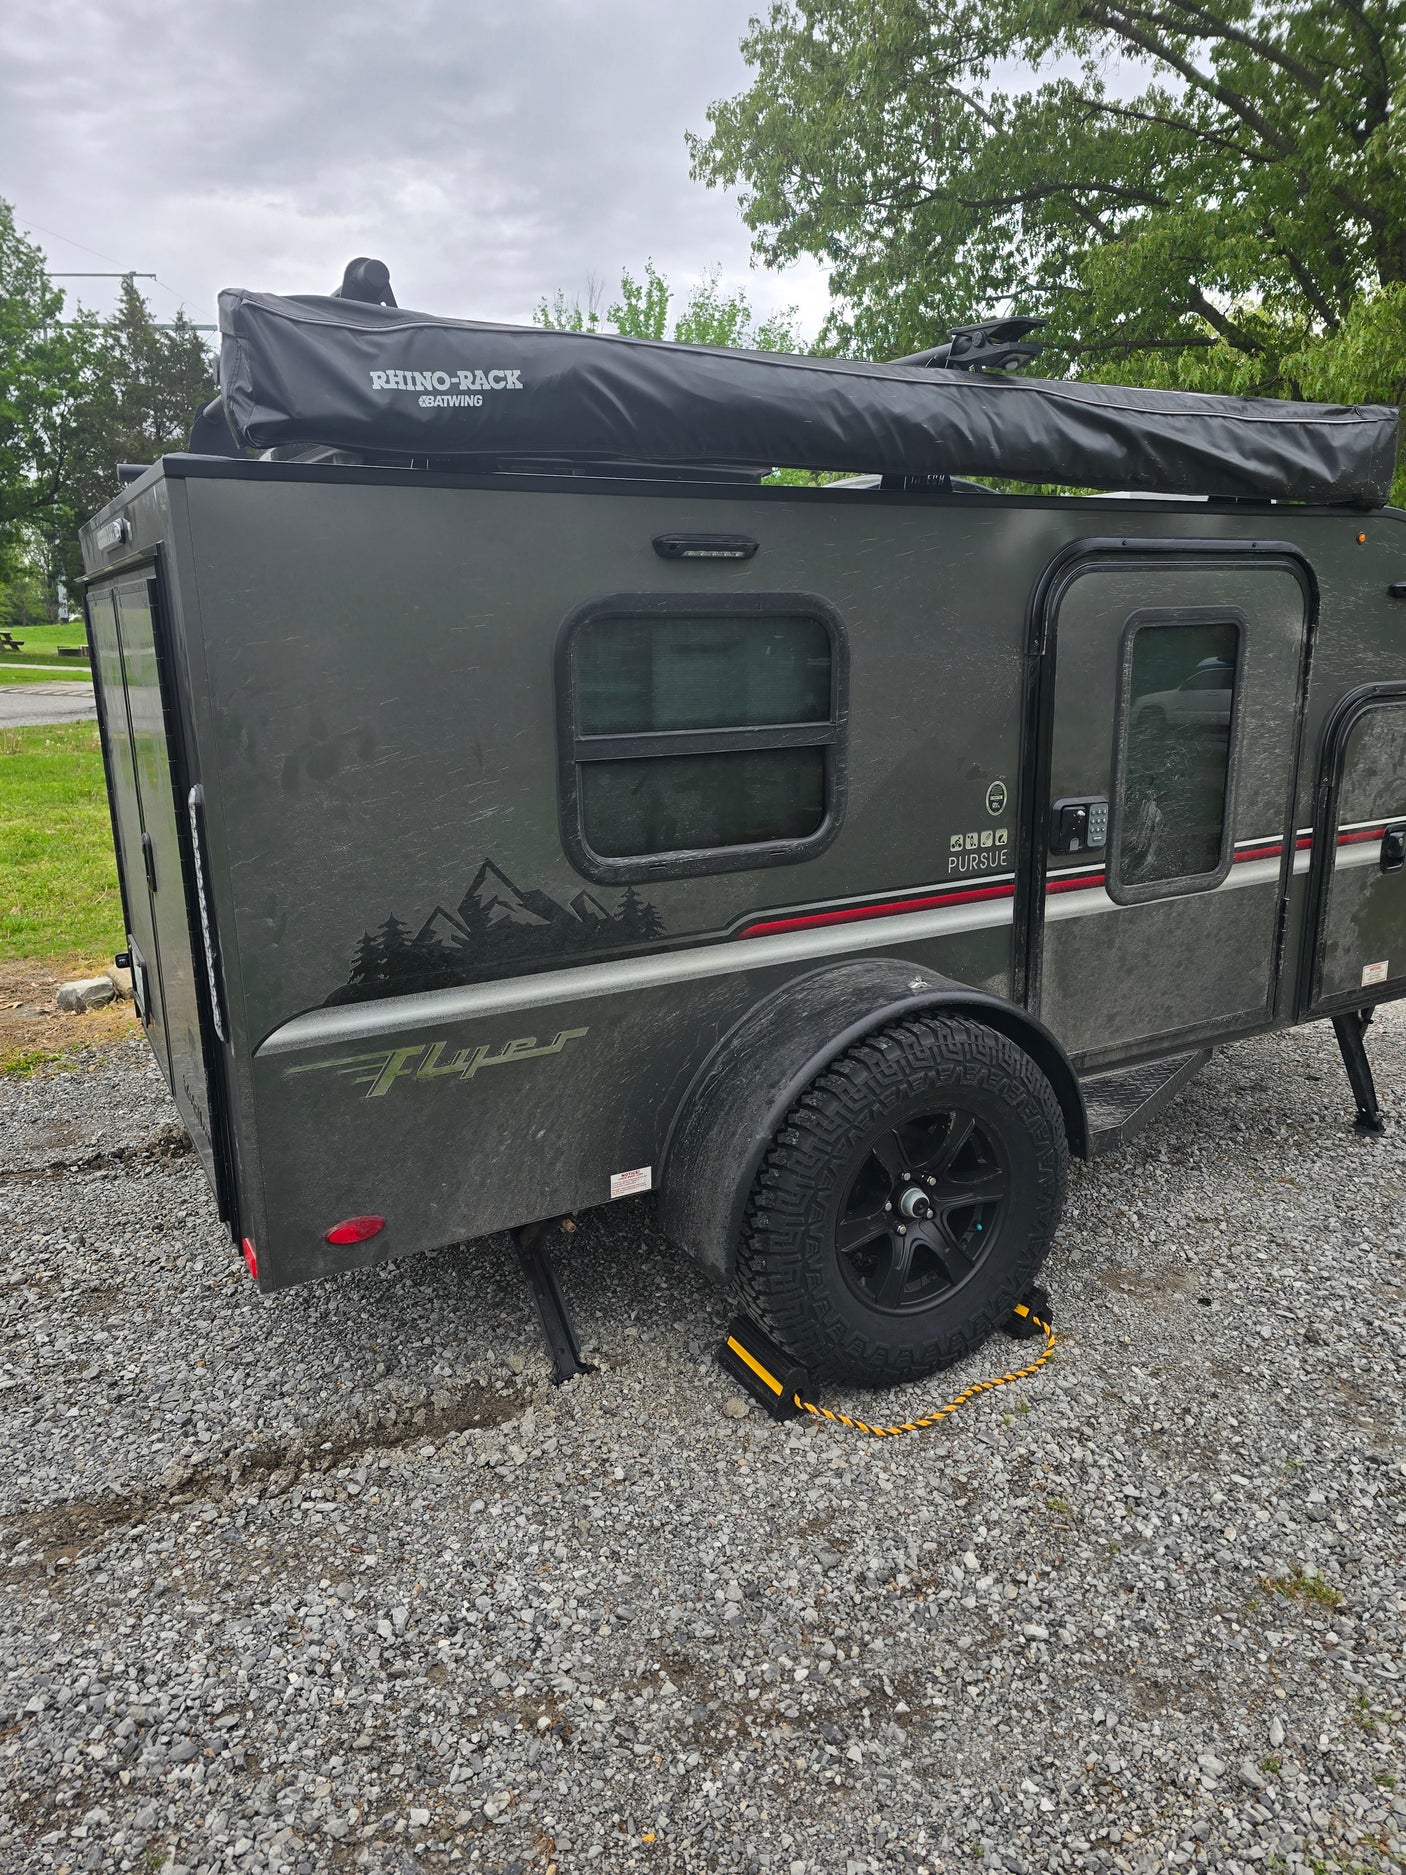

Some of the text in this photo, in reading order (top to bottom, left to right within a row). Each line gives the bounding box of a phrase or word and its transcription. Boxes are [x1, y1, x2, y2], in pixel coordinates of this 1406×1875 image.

[369, 369, 524, 391] RHINO-RACK
[426, 394, 484, 408] BATWING
[948, 849, 1008, 874] PURSUE
[355, 1026, 590, 1098] Flyer
